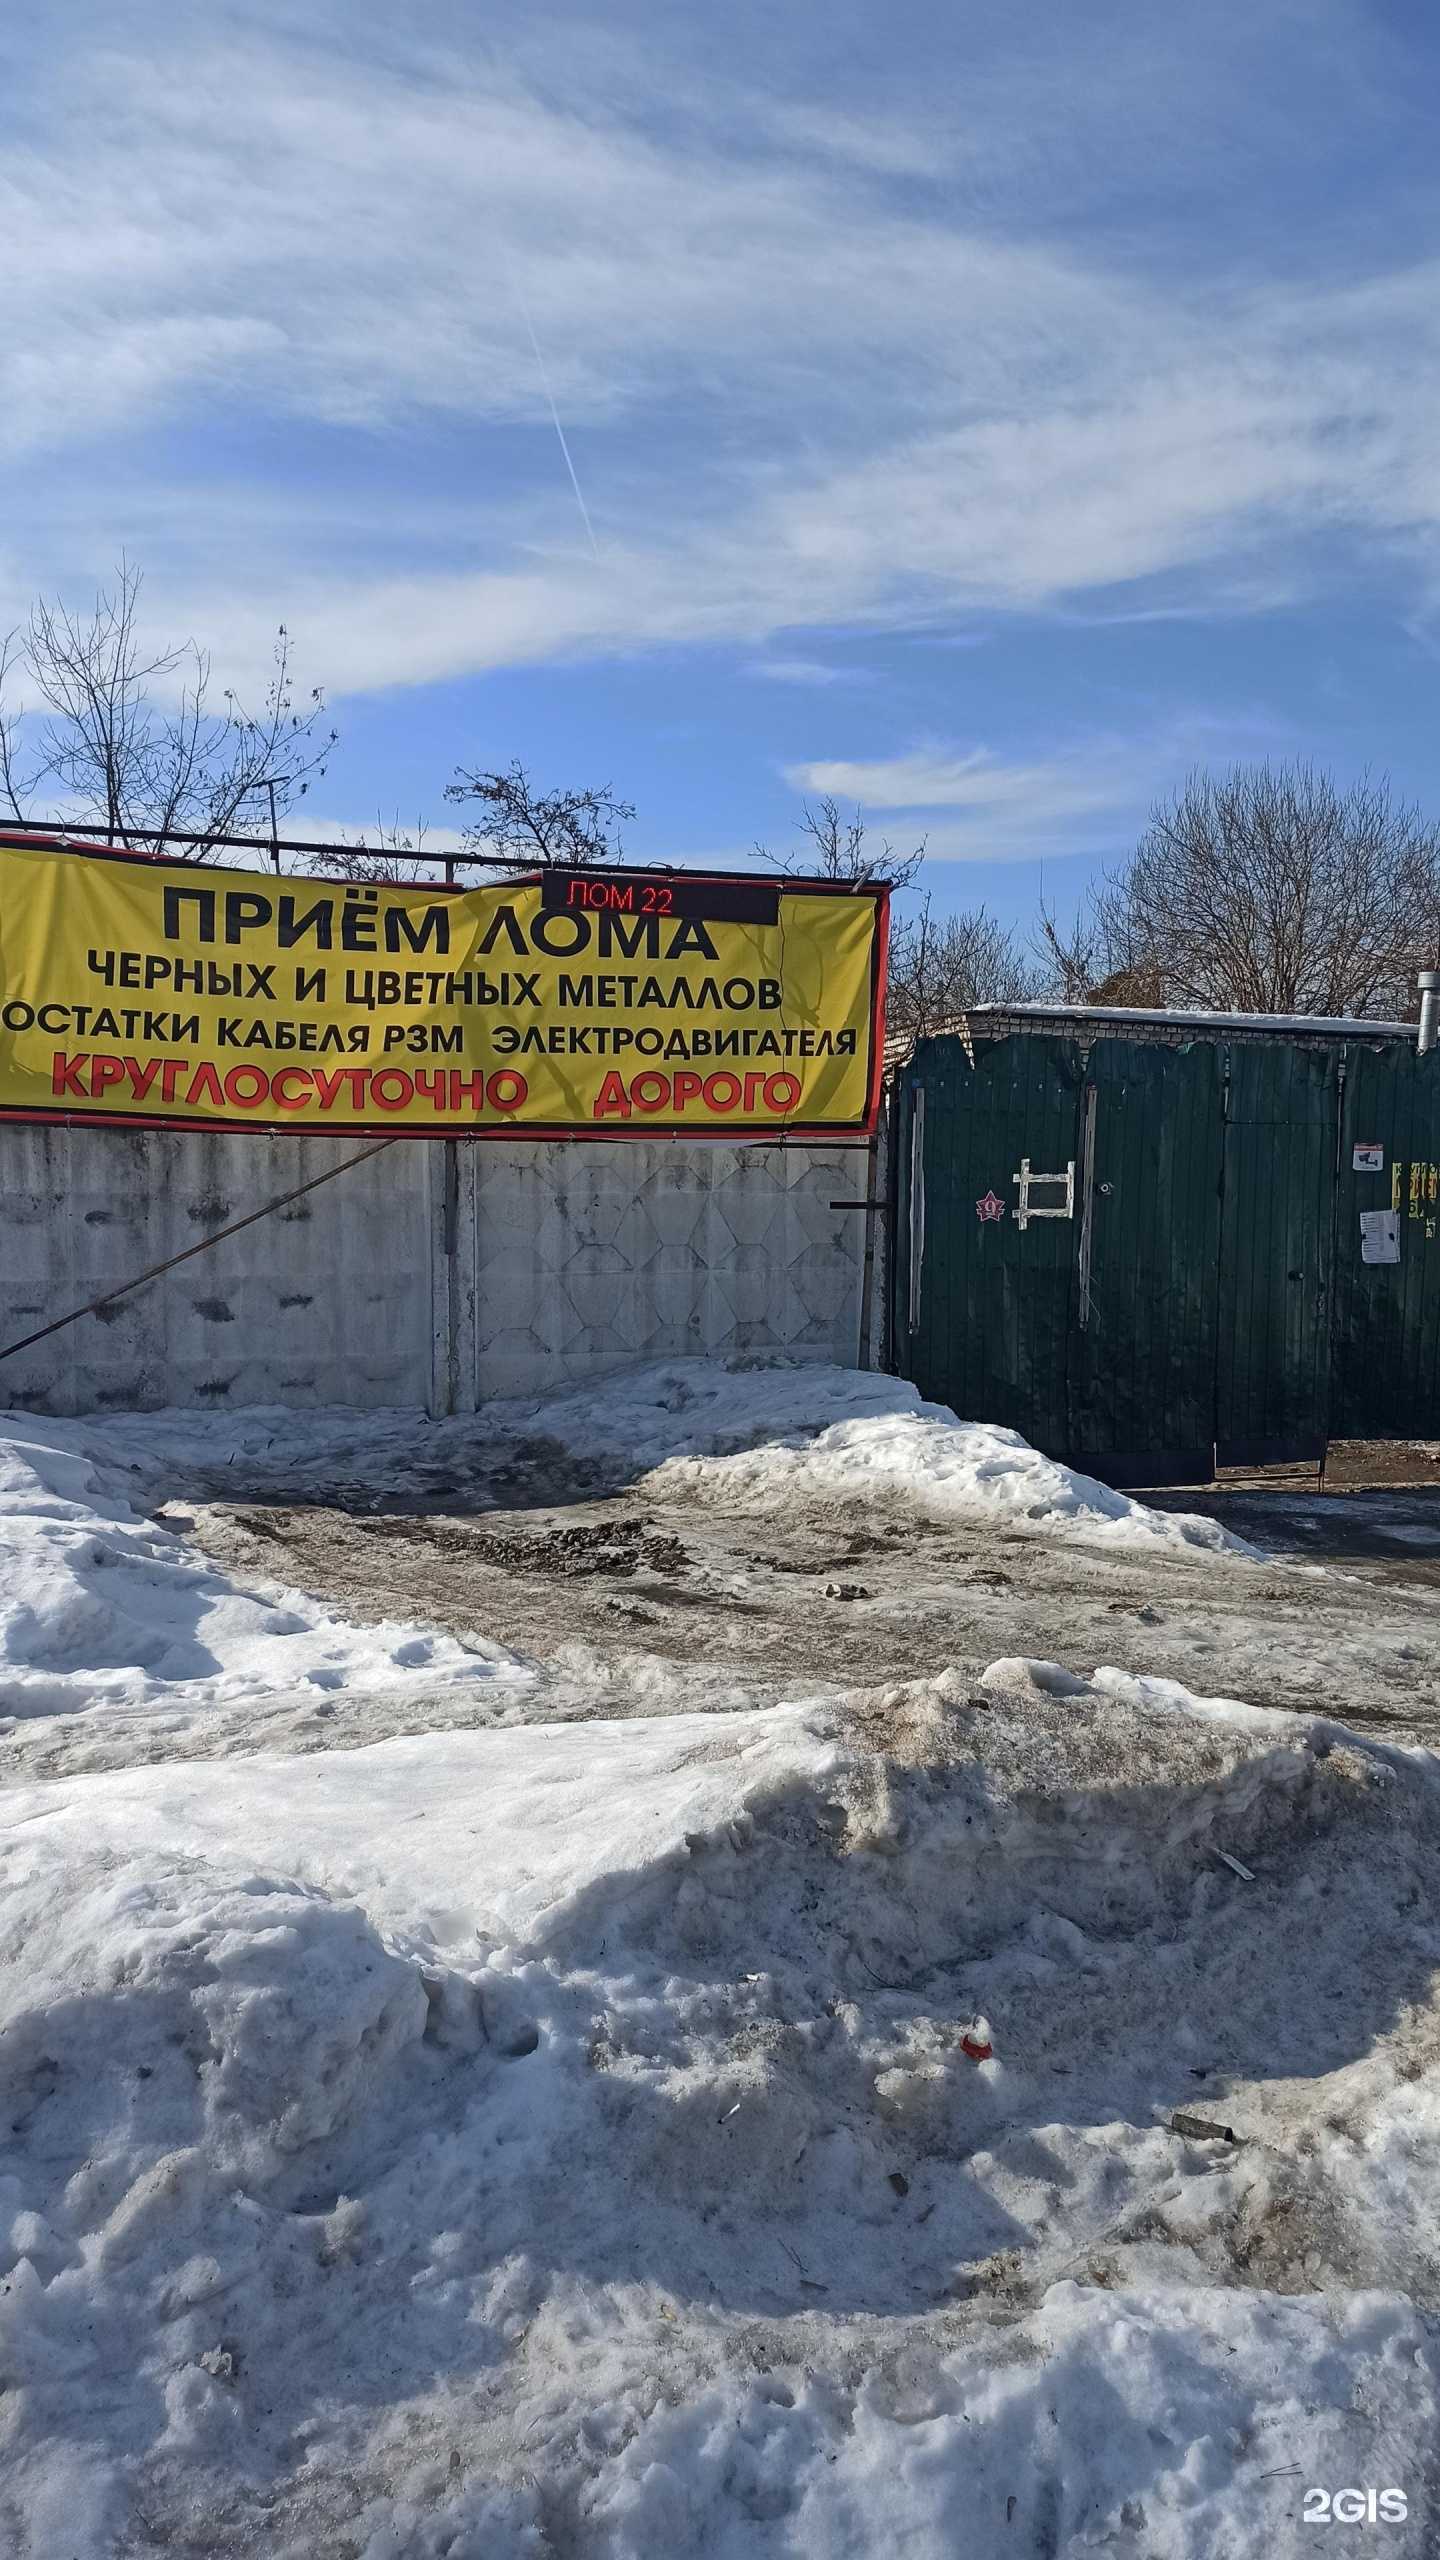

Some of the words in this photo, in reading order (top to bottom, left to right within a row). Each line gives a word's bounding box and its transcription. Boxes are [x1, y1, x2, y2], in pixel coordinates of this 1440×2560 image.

[163, 886, 450, 954] ПРИЁМ
[477, 904, 720, 961] ЛОМА
[641, 888, 673, 914] 22
[87, 949, 278, 1000] ЧЕРНЫХ
[295, 966, 327, 1003] И
[345, 969, 542, 1010] ЦВЕТНЫХ
[558, 974, 783, 1010] МЕТАЛЛОВ
[1, 1001, 200, 1044] ОСТАТКИ
[218, 1017, 370, 1052] КАБЕЛЯ
[383, 1024, 464, 1053] РЗМ
[491, 1025, 857, 1060] ЭЛЕКТРОДВИГАТЕЛЯ
[51, 1051, 529, 1112] КРУГЛОСУТОЧНО
[593, 1070, 802, 1118] ДОРОГО
